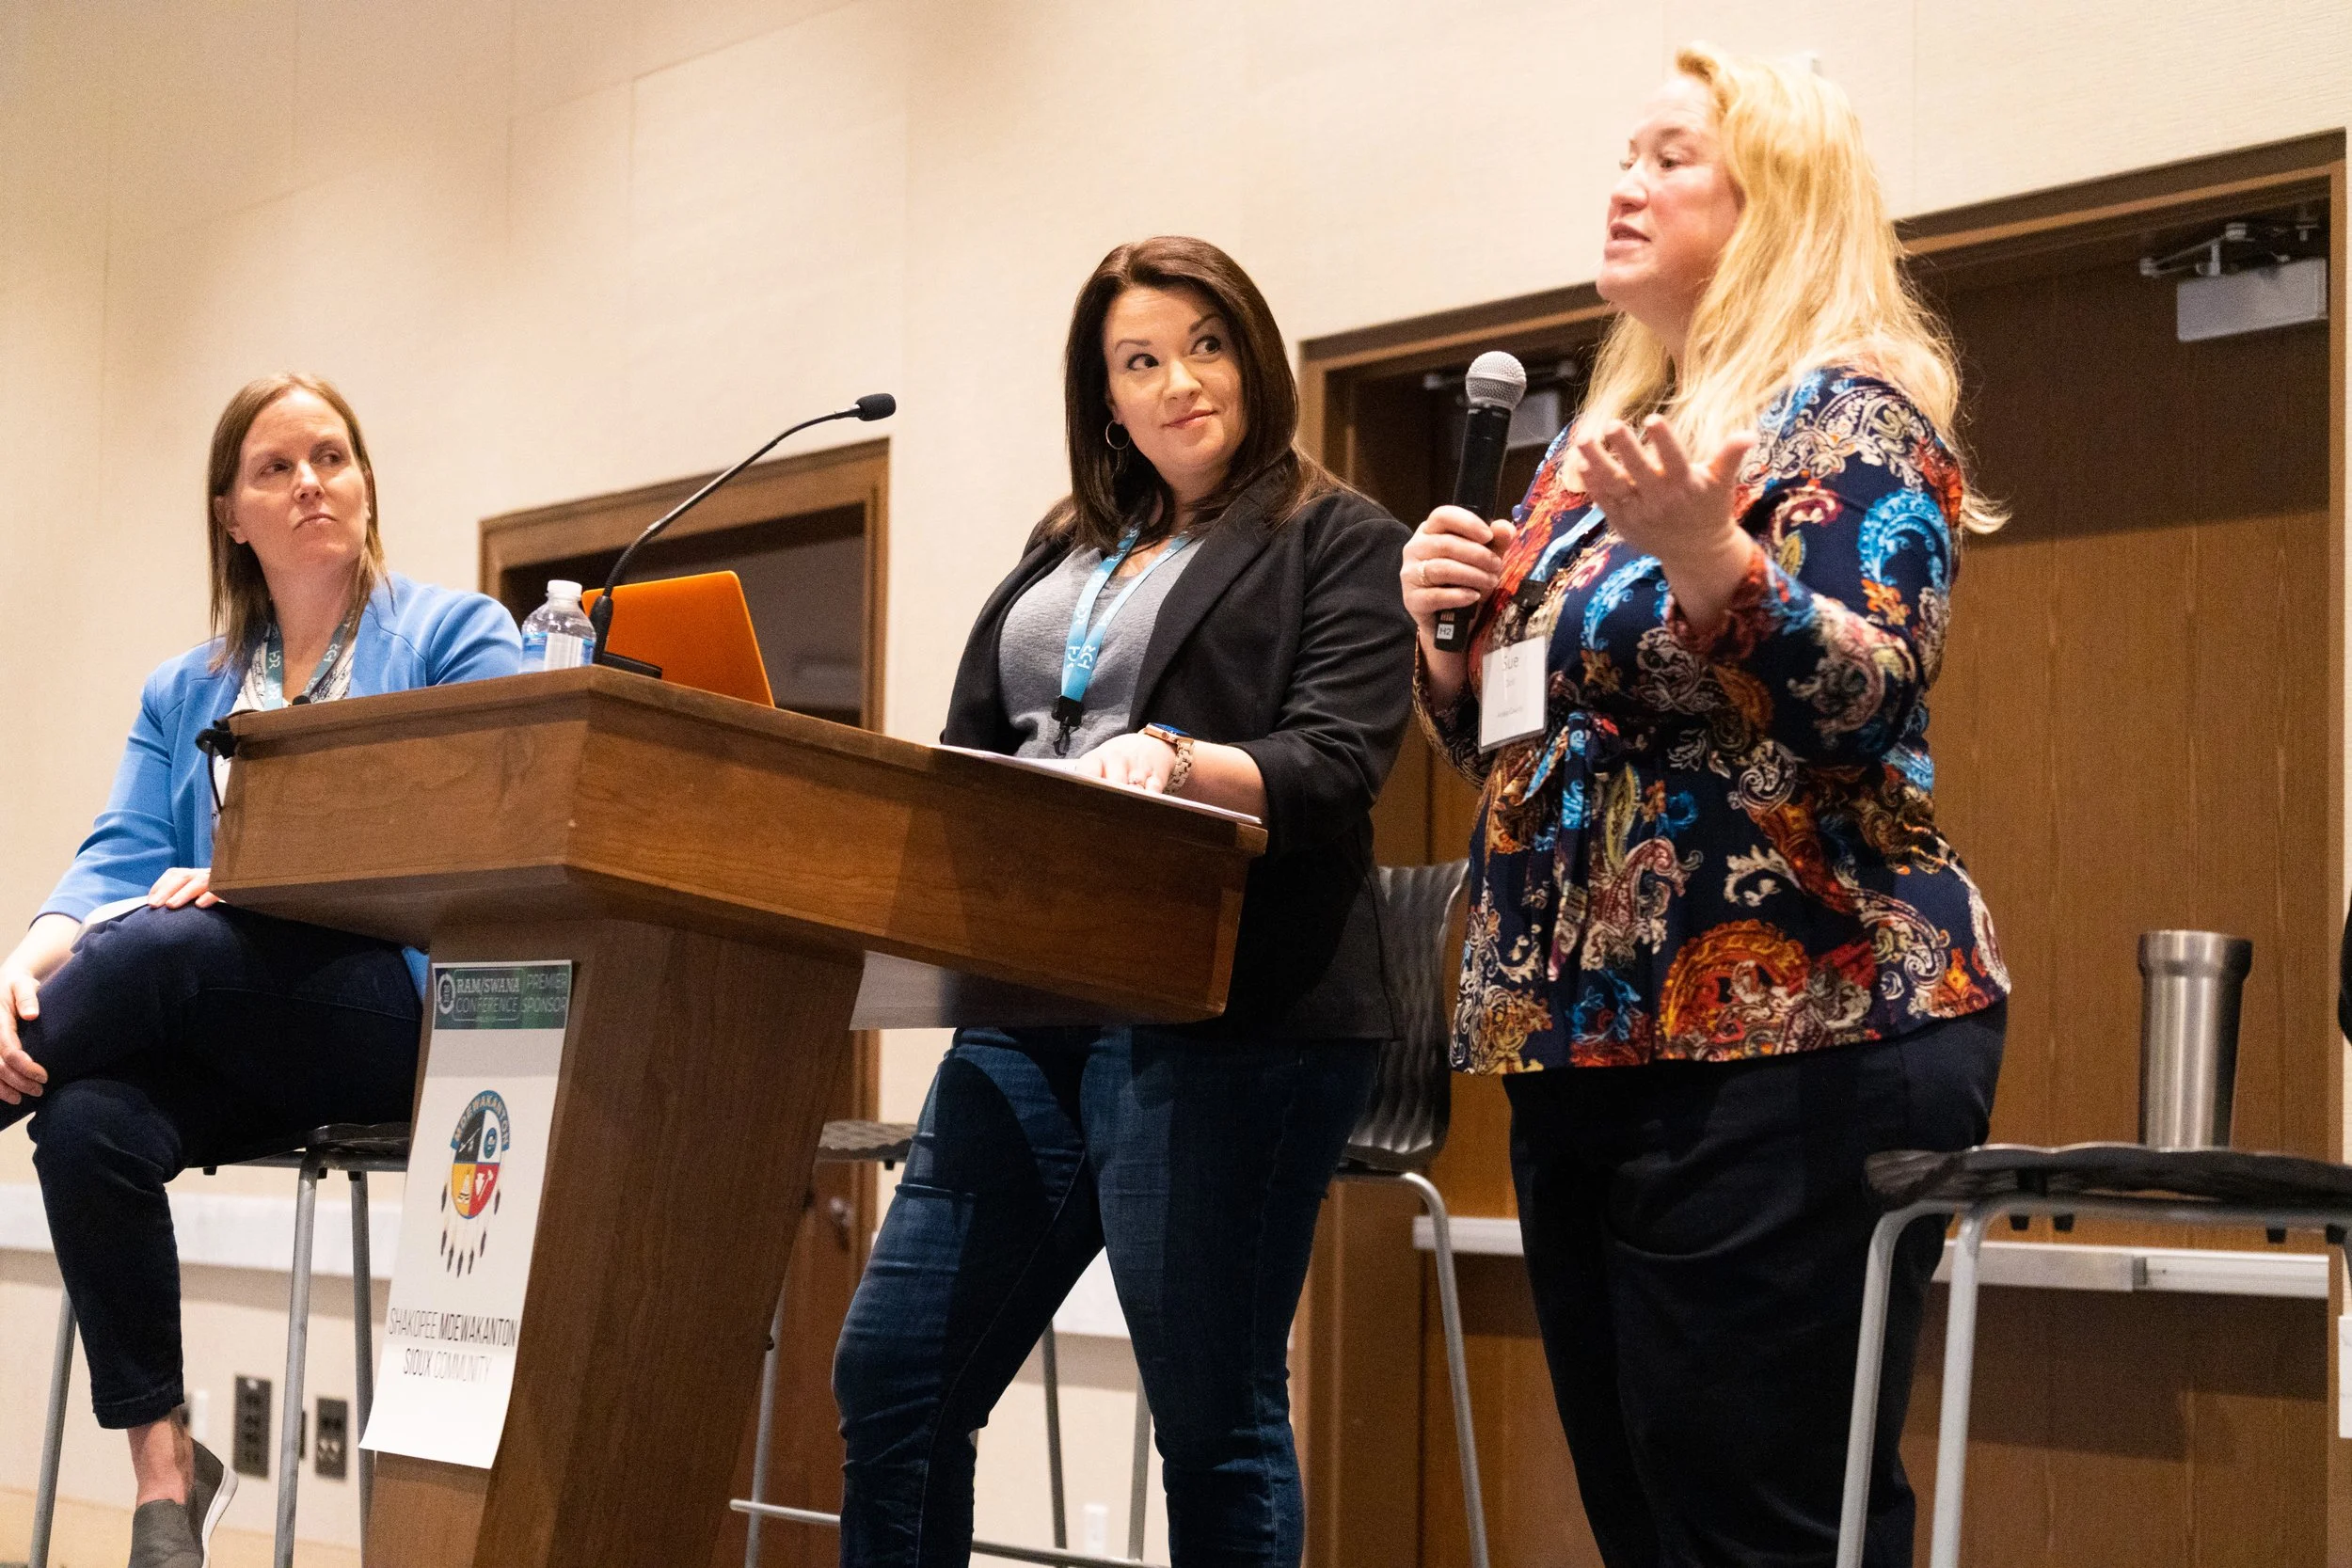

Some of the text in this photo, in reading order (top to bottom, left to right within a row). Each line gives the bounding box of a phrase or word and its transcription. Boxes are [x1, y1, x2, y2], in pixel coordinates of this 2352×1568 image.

[1439, 627, 1452, 636] H2
[456, 976, 520, 994] RAM/SWANA
[527, 973, 567, 990] PREMIER
[455, 996, 567, 1013] CONFERENCE SPONSOR
[389, 1307, 518, 1347] SHAKOPEE MDEWAKANTON
[404, 1348, 492, 1383] SIOUX COMMUNITY
